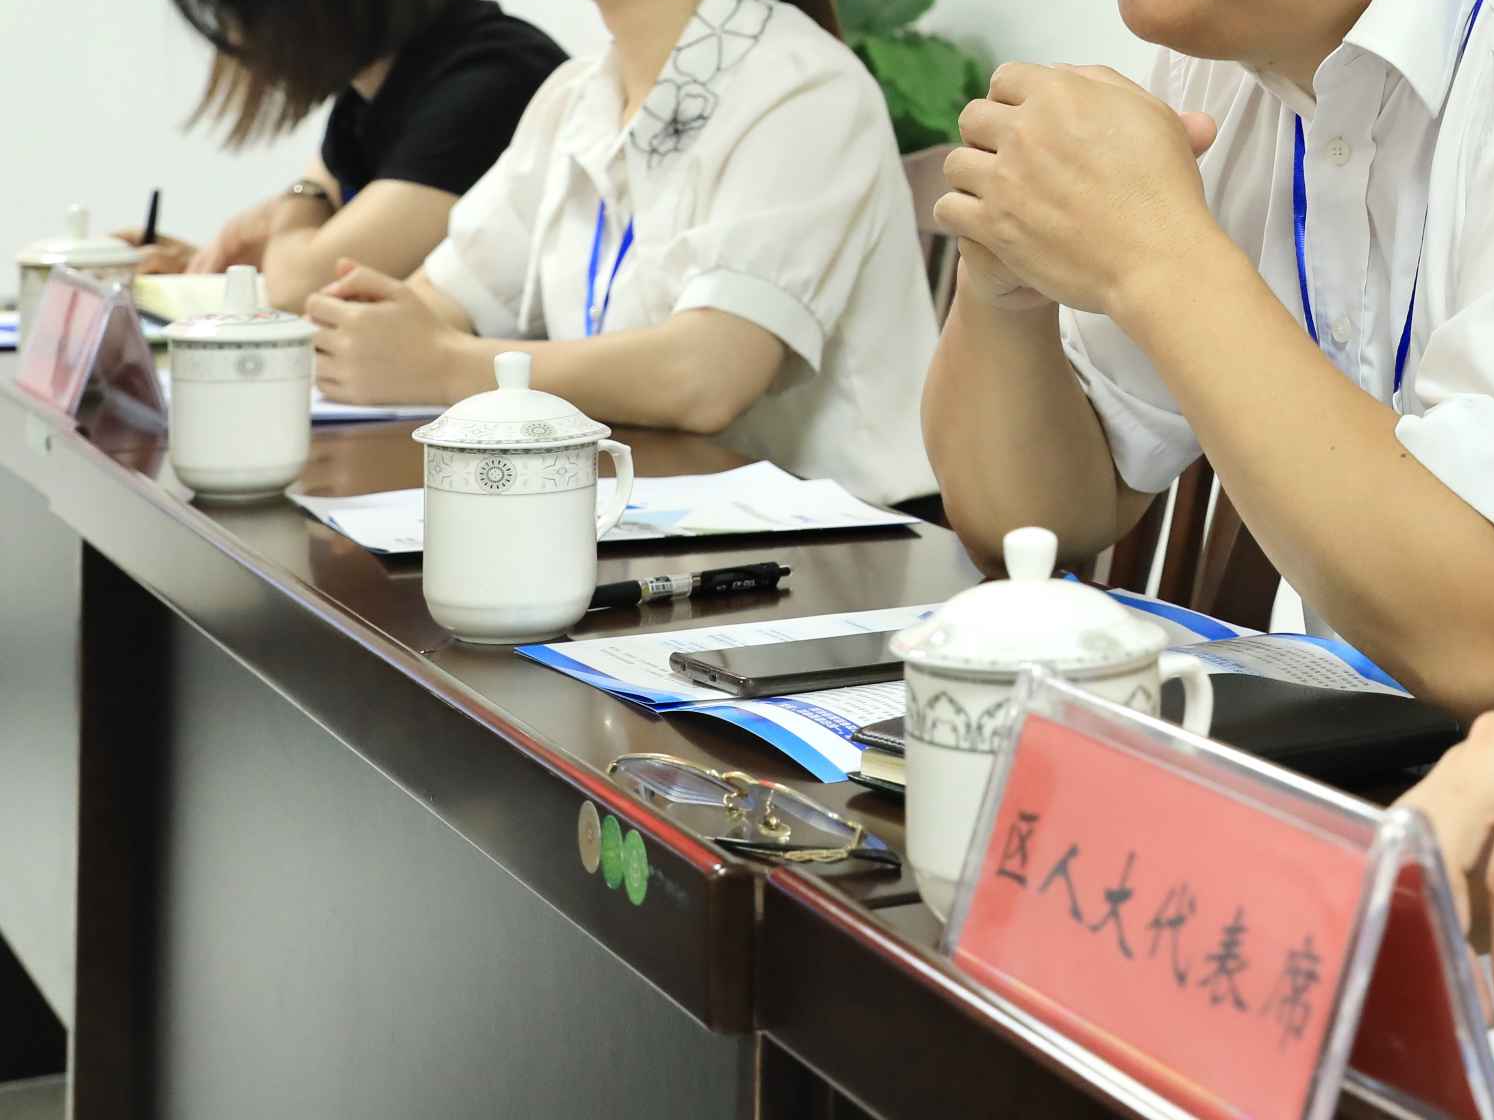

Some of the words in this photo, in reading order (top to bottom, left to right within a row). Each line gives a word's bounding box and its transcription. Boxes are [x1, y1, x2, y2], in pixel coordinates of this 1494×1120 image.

[996, 810, 1321, 1050] 区人大代表席
